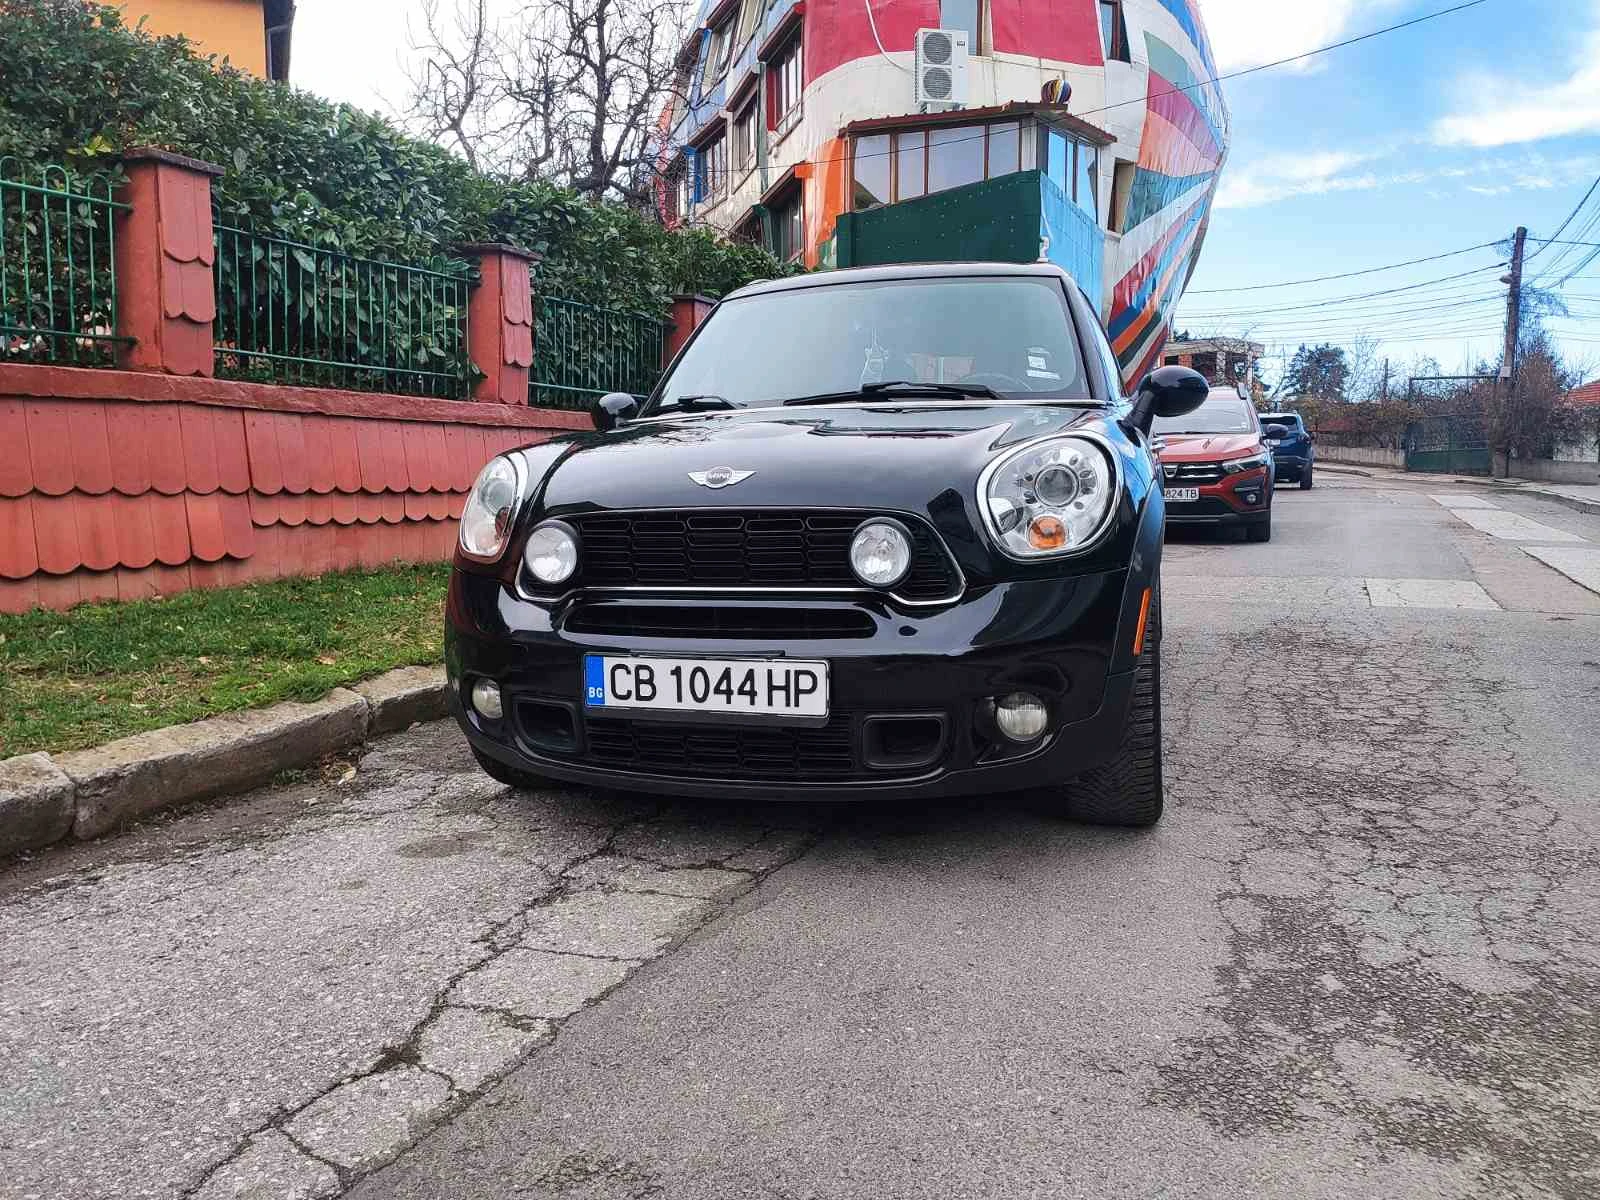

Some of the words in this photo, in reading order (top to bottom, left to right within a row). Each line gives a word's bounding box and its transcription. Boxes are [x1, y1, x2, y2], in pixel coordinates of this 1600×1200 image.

[1185, 489, 1197, 498] TB
[610, 664, 657, 701] CB
[670, 665, 757, 706] 1044
[767, 668, 818, 707] HP
[588, 686, 603, 698] BG
